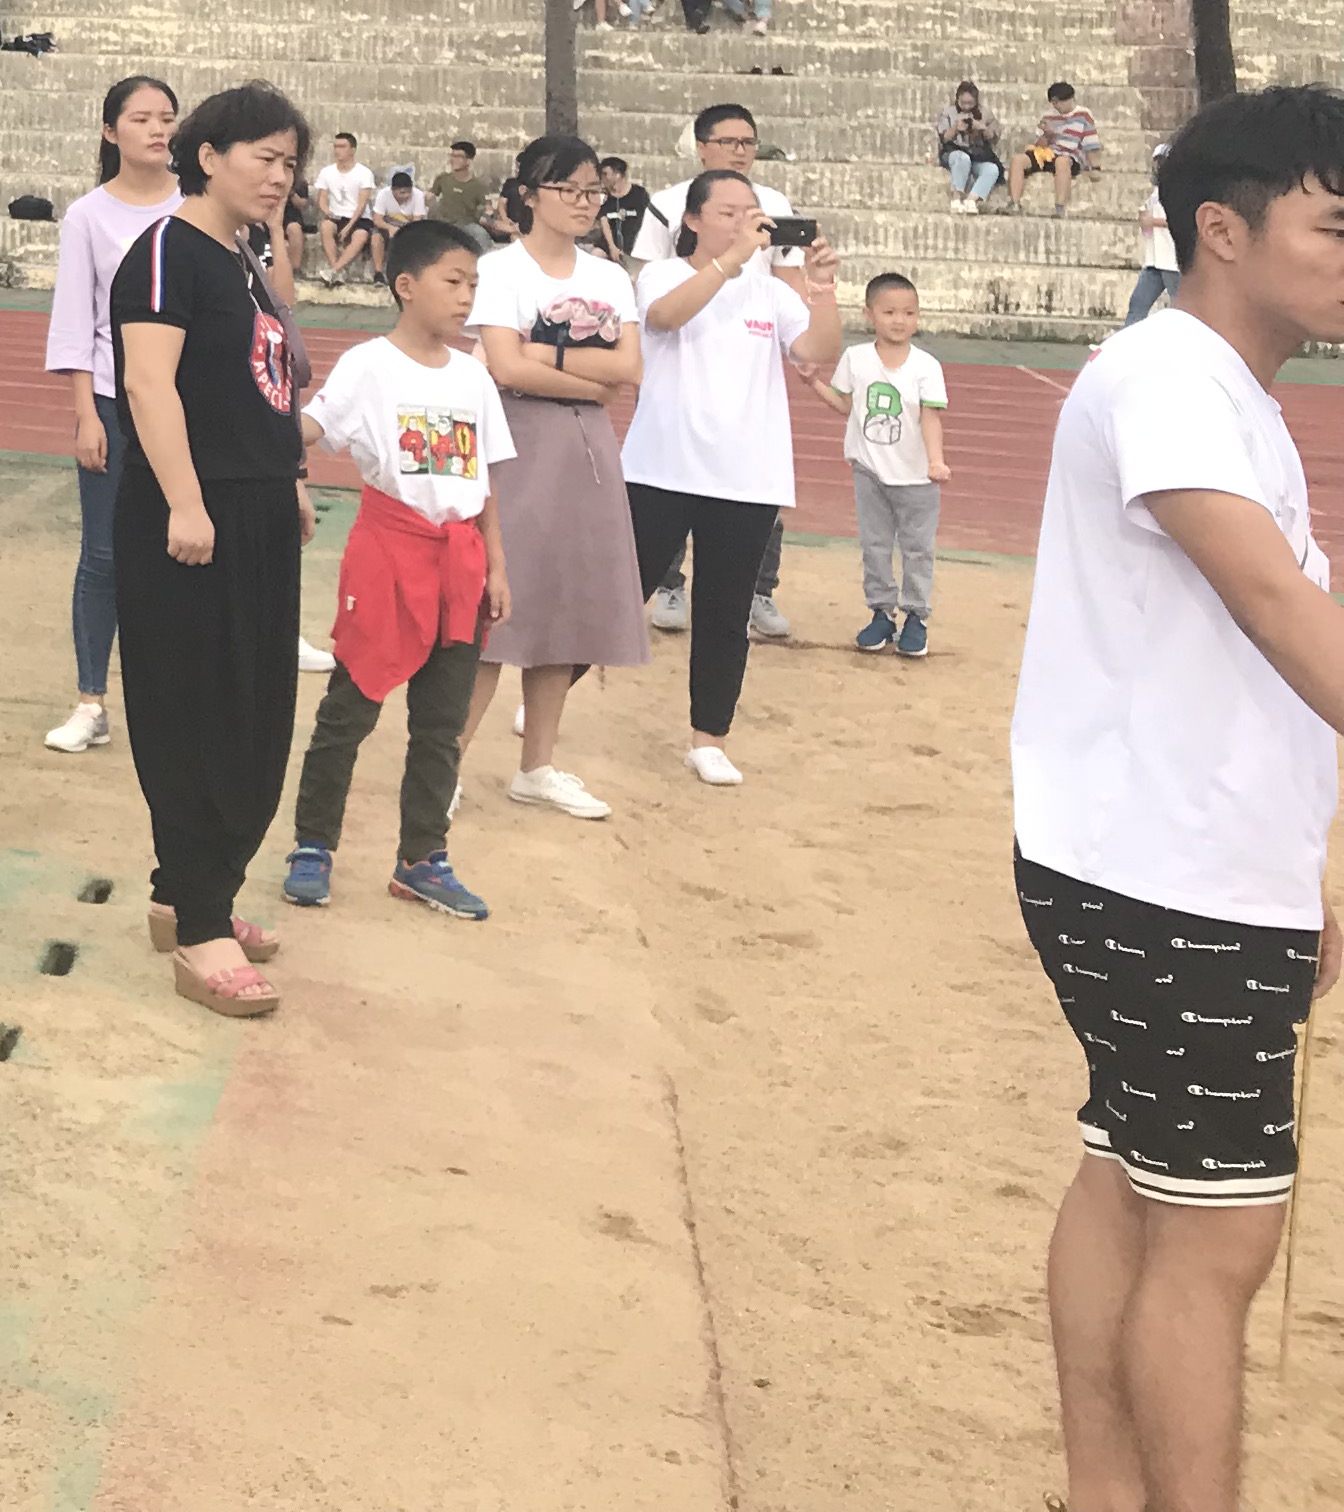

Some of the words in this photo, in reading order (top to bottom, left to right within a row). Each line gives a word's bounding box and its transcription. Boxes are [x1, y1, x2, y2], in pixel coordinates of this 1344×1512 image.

[1171, 938, 1241, 953] Champion
[1181, 1011, 1254, 1027] Champion
[1187, 1084, 1262, 1101] Champion
